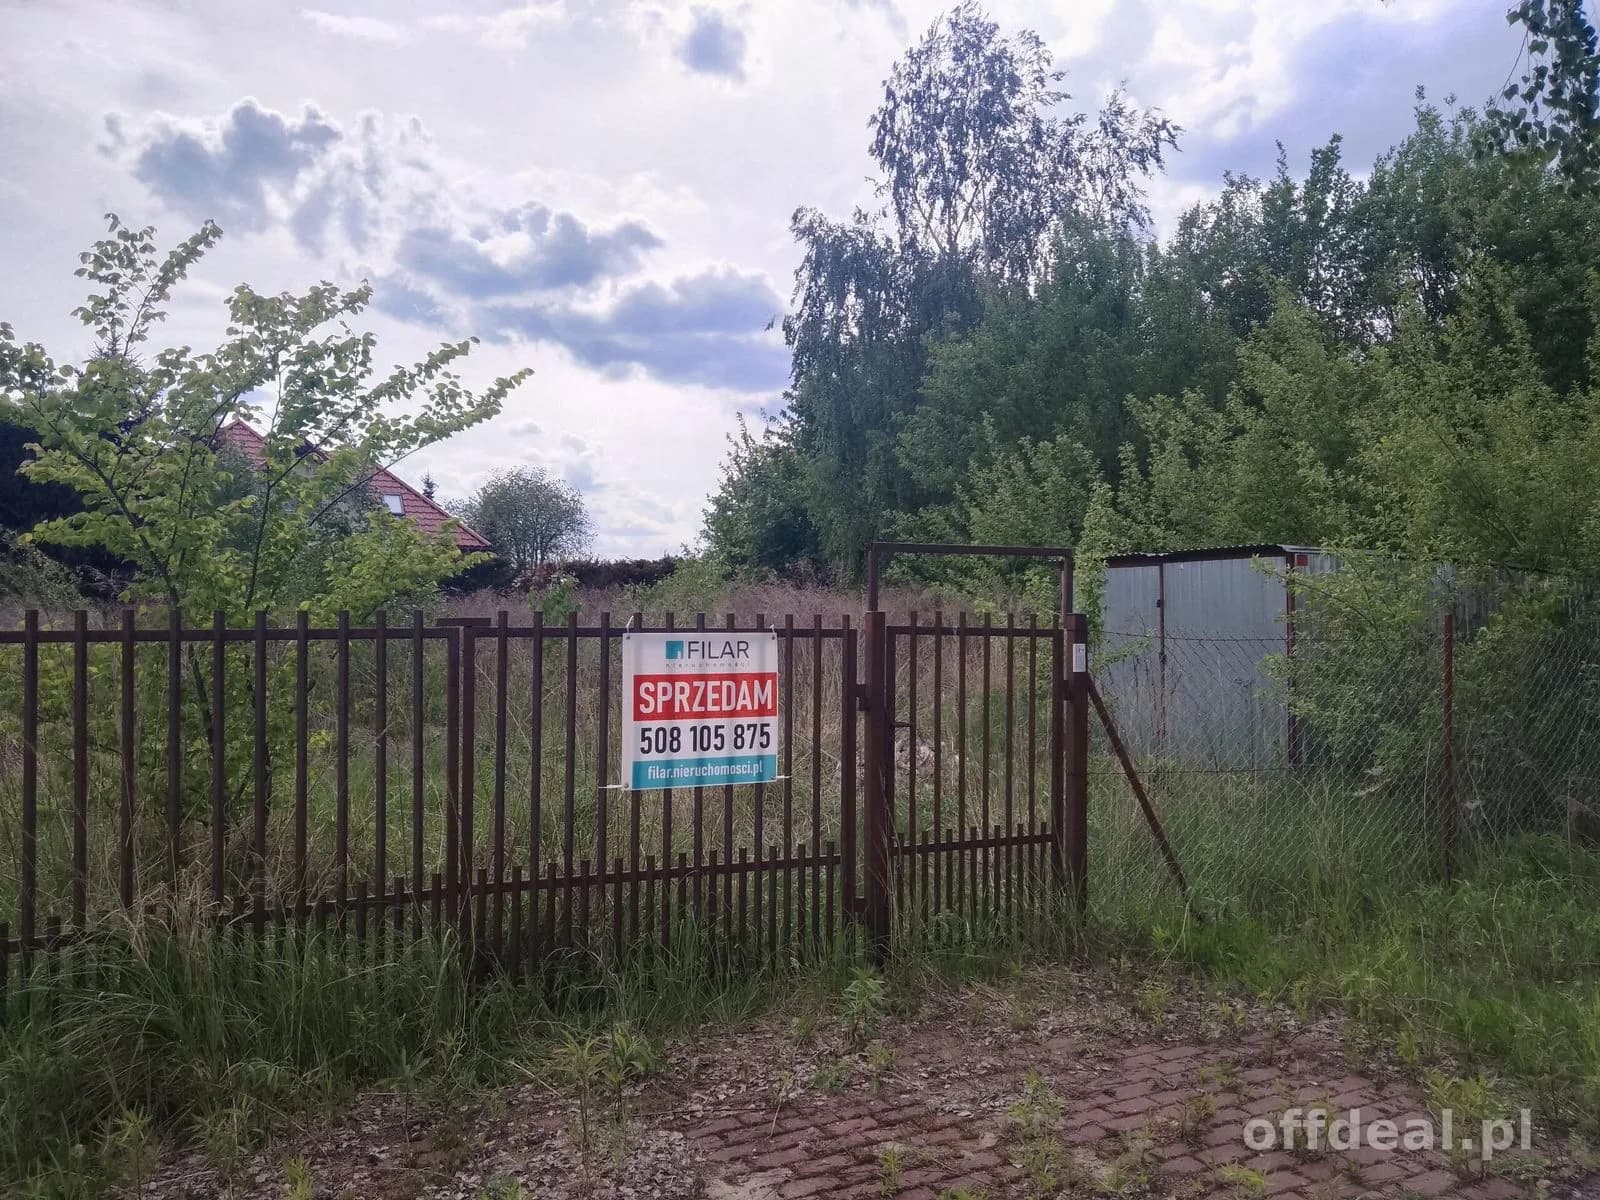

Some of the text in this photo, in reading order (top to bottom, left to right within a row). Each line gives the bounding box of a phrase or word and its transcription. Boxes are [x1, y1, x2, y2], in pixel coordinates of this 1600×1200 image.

[687, 640, 750, 659] FILAR
[639, 679, 772, 714] SPRZEDAM
[640, 723, 771, 754] 508 105 875
[647, 760, 763, 780] filar.nieruchomosci.pl
